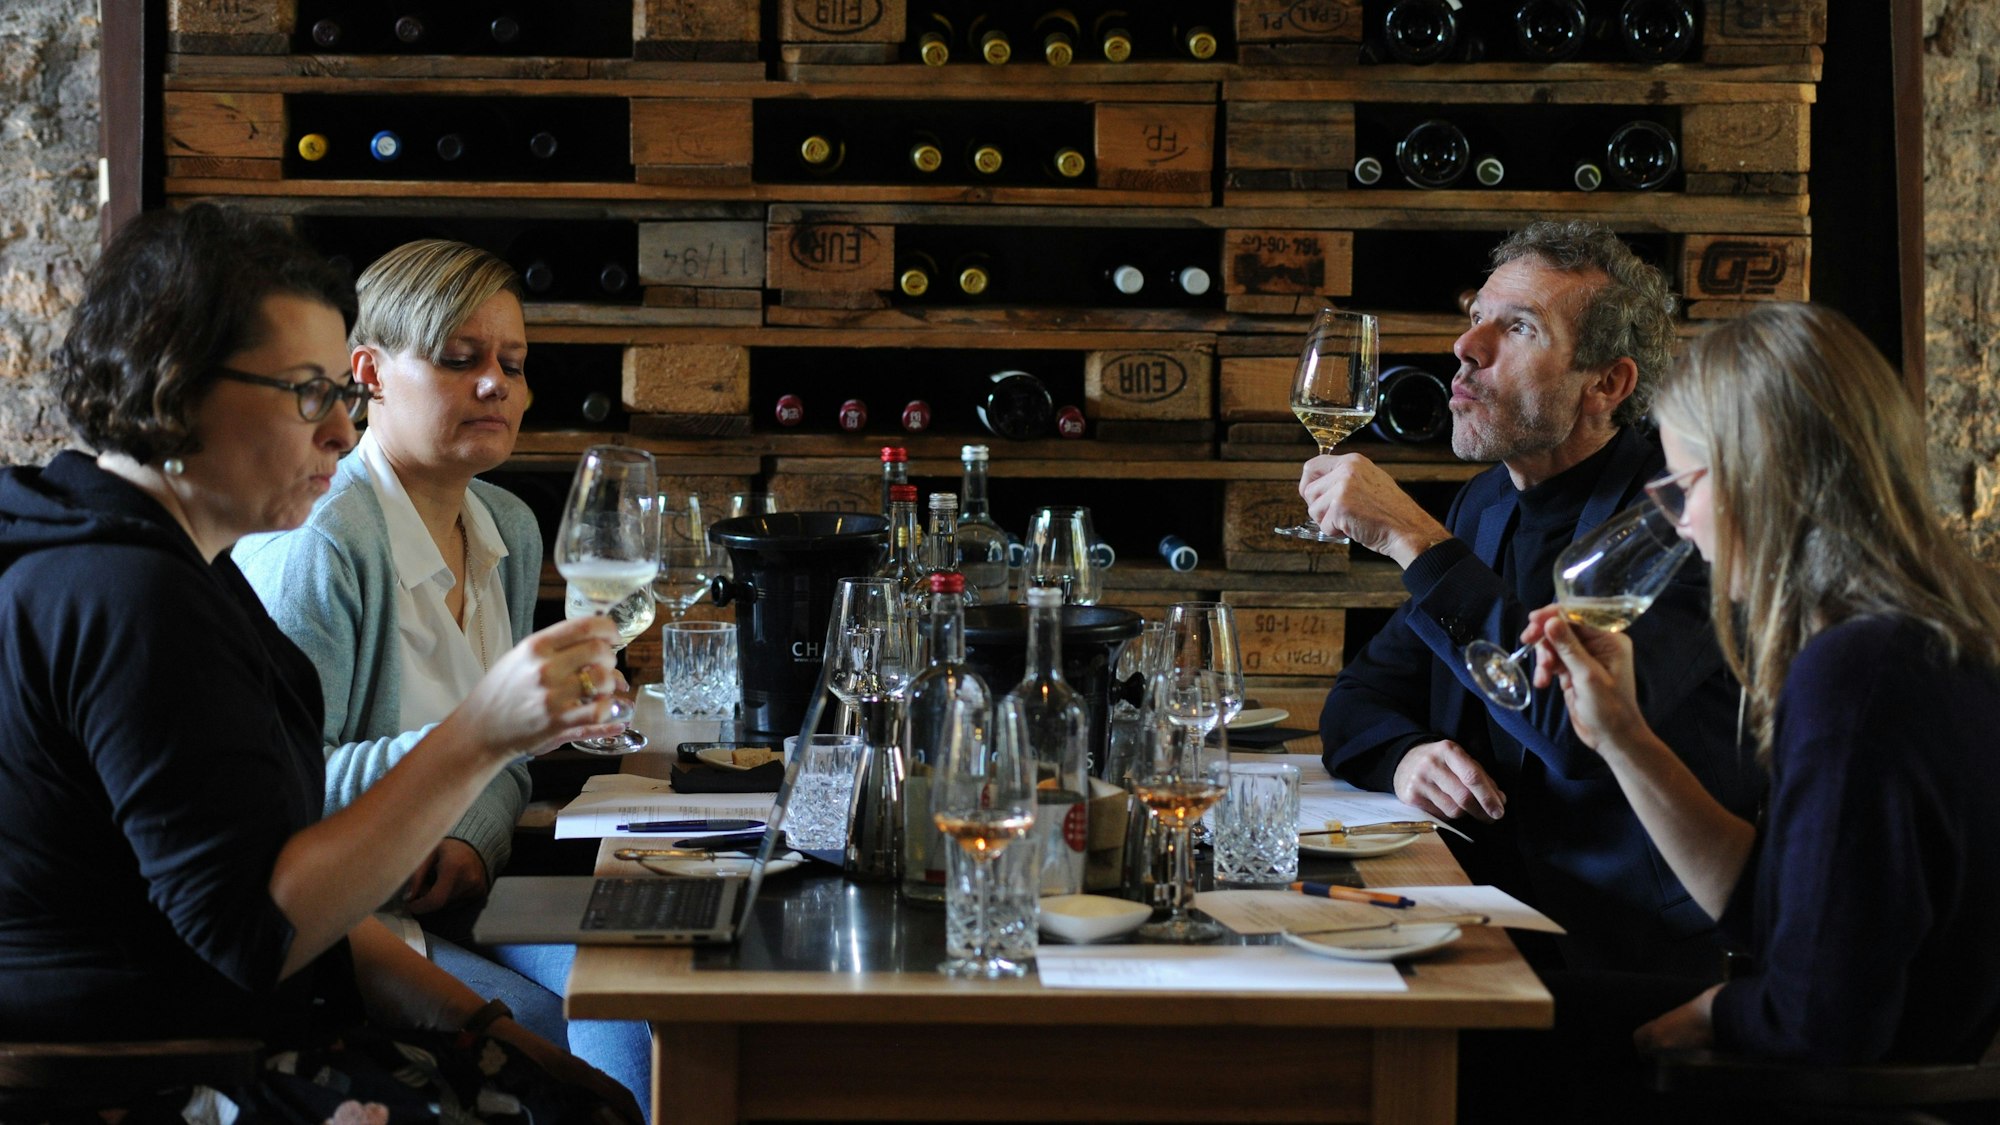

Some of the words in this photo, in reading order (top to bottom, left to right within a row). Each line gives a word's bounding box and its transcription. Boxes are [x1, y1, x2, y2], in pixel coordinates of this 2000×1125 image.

[663, 242, 749, 279] 11/94
[808, 232, 861, 264] EUR
[1119, 362, 1167, 391] EUR
